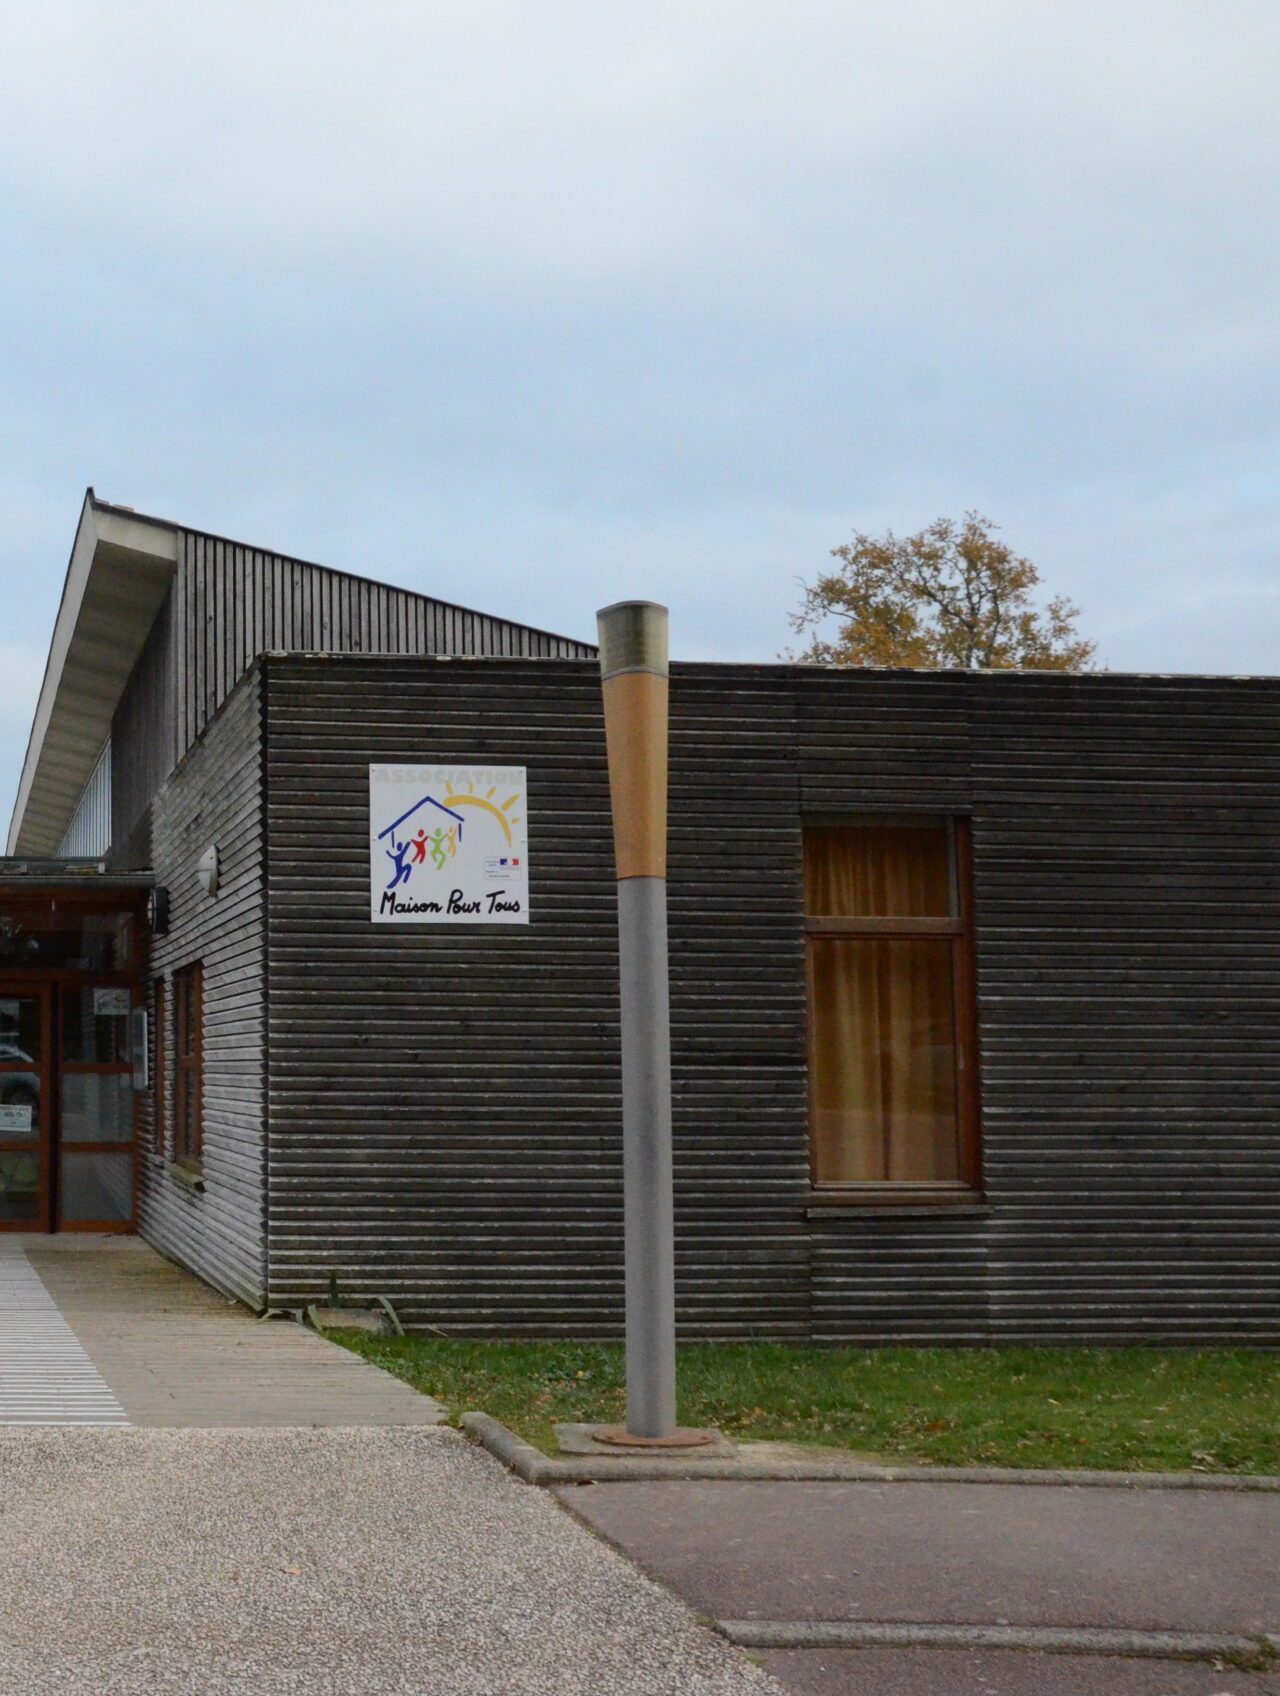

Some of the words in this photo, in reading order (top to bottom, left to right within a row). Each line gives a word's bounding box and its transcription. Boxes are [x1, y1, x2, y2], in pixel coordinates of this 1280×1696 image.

[374, 768, 524, 786] ASSOCIATION
[380, 890, 443, 915] Maison
[446, 889, 481, 914] Pour
[486, 890, 521, 914] Tous
